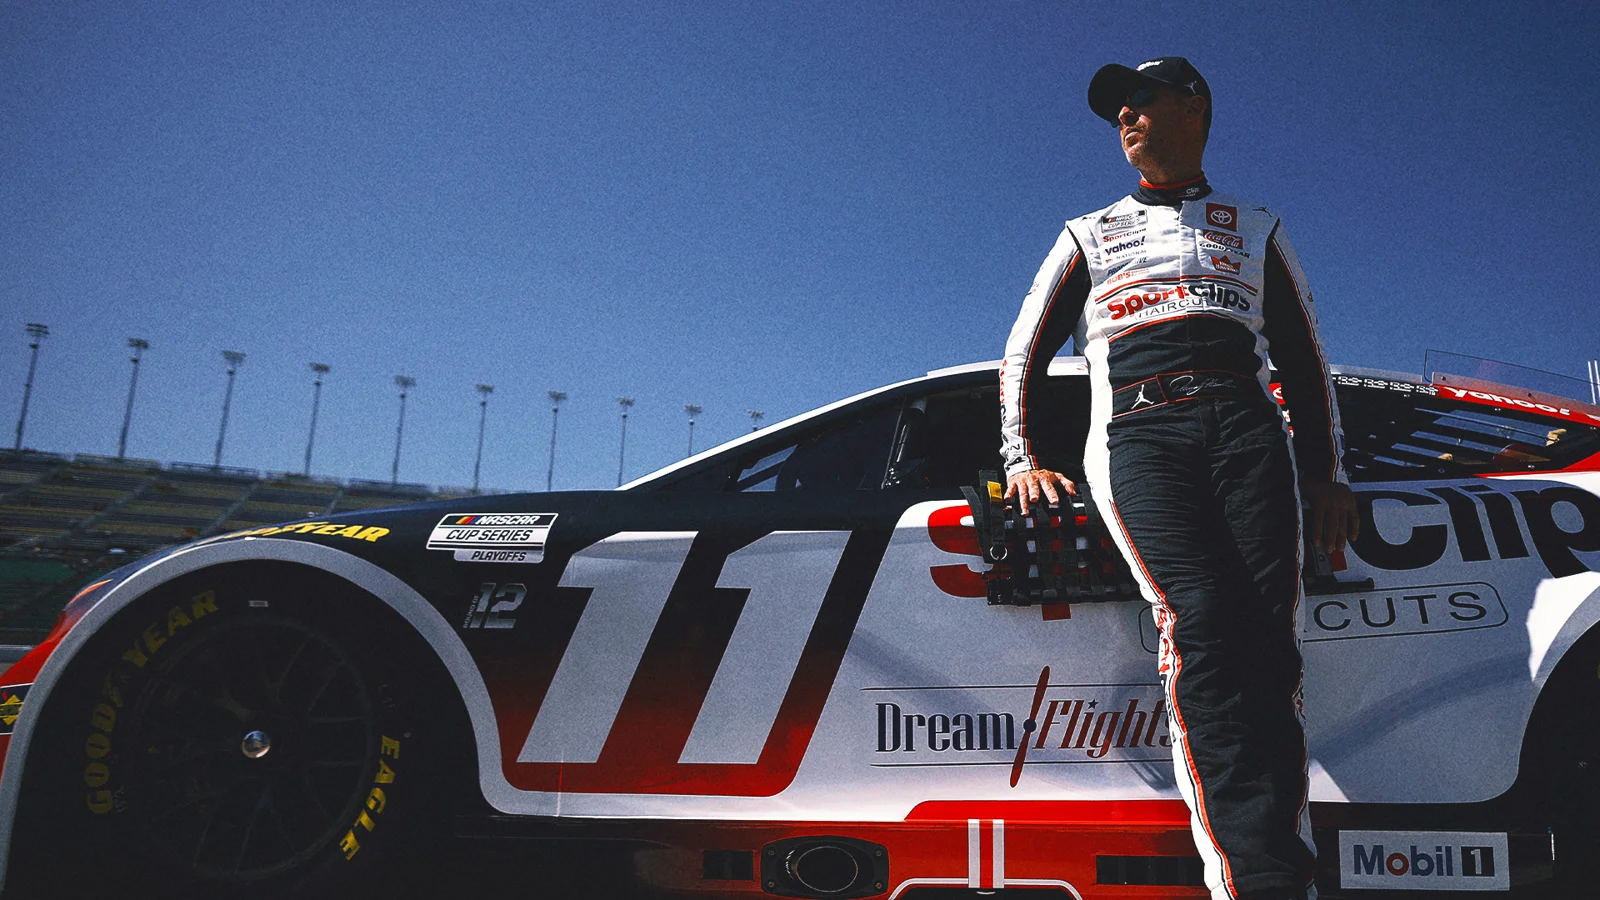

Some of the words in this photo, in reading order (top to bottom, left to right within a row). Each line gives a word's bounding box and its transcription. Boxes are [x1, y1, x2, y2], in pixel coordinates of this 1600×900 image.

[1120, 218, 1140, 227] SERI
[1105, 236, 1146, 256] yahoo!
[1138, 298, 1206, 318] HAIRCU
[445, 529, 480, 541] CUP
[477, 529, 534, 541] SERIES
[475, 515, 541, 525] NASCAR
[173, 521, 390, 553] ODYEAR
[471, 550, 527, 562] PLAYOFFS
[469, 582, 528, 629] 12
[1313, 591, 1488, 631] CUTS
[517, 531, 852, 764] 11
[83, 590, 221, 814] GOODYEAR
[875, 702, 1018, 752] Dream
[338, 734, 402, 861] EAGLE
[1353, 844, 1454, 876] Mobil
